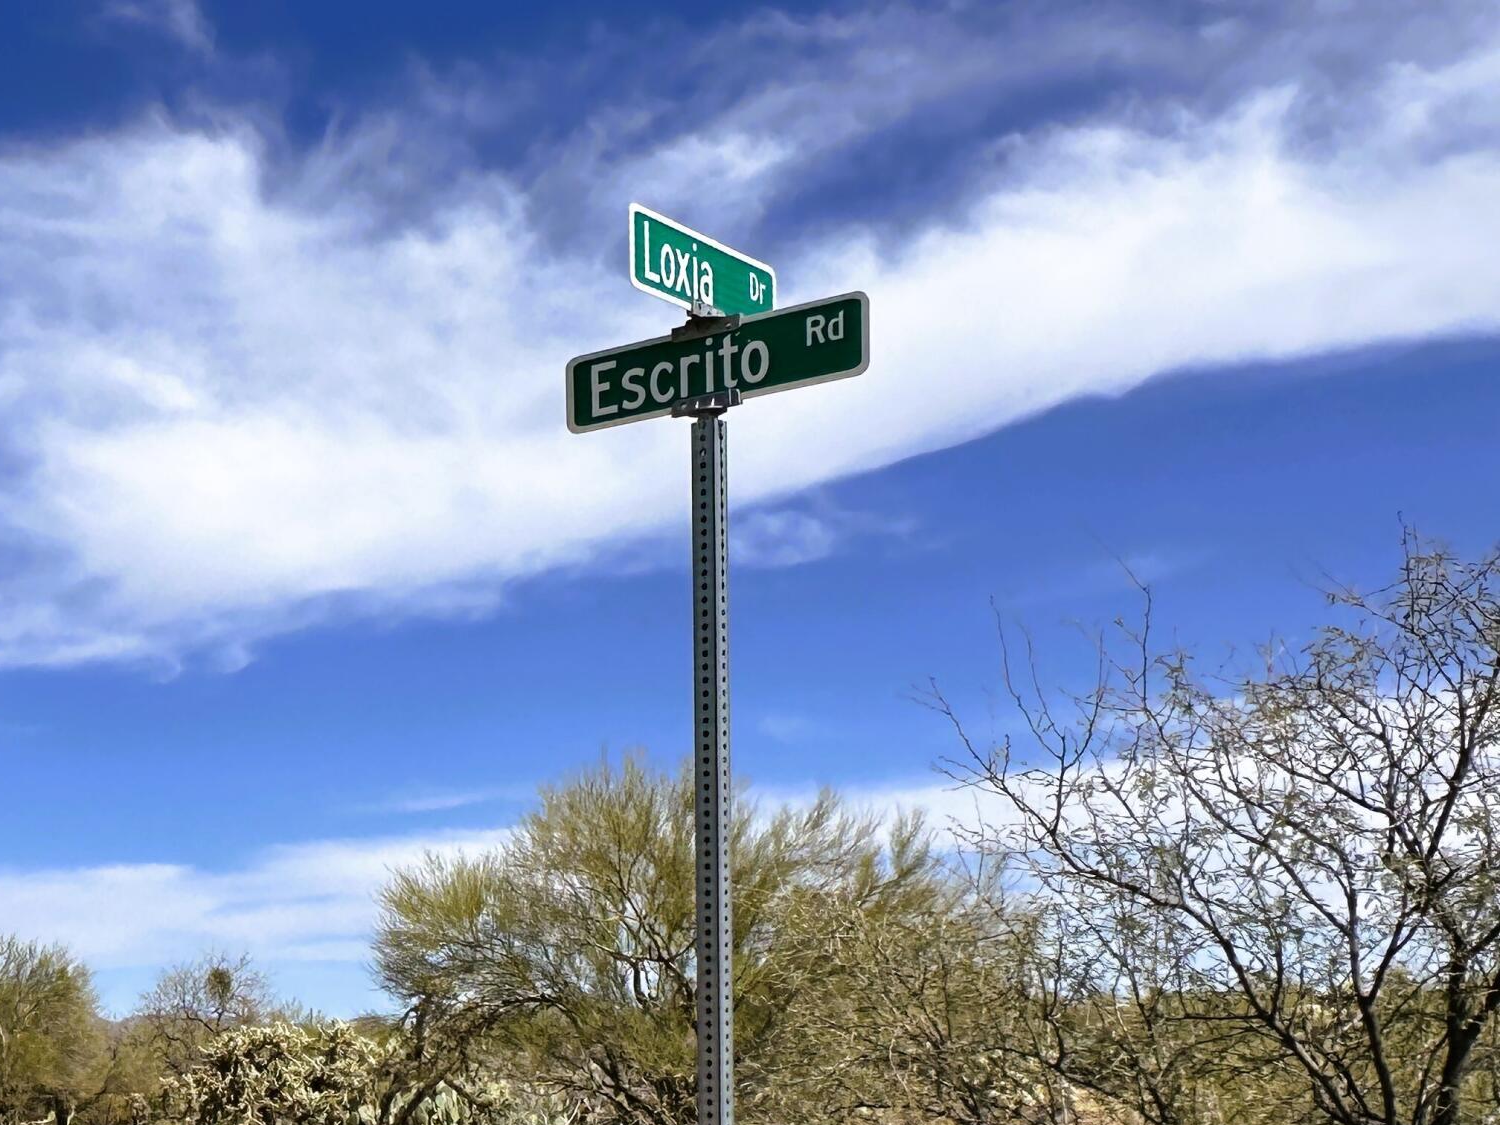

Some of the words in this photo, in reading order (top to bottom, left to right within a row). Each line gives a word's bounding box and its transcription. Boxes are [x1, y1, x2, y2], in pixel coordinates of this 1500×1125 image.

[644, 220, 713, 306] Loxia
[749, 272, 766, 304] Dr
[591, 333, 769, 417] Escrito
[806, 310, 844, 346] Rd
